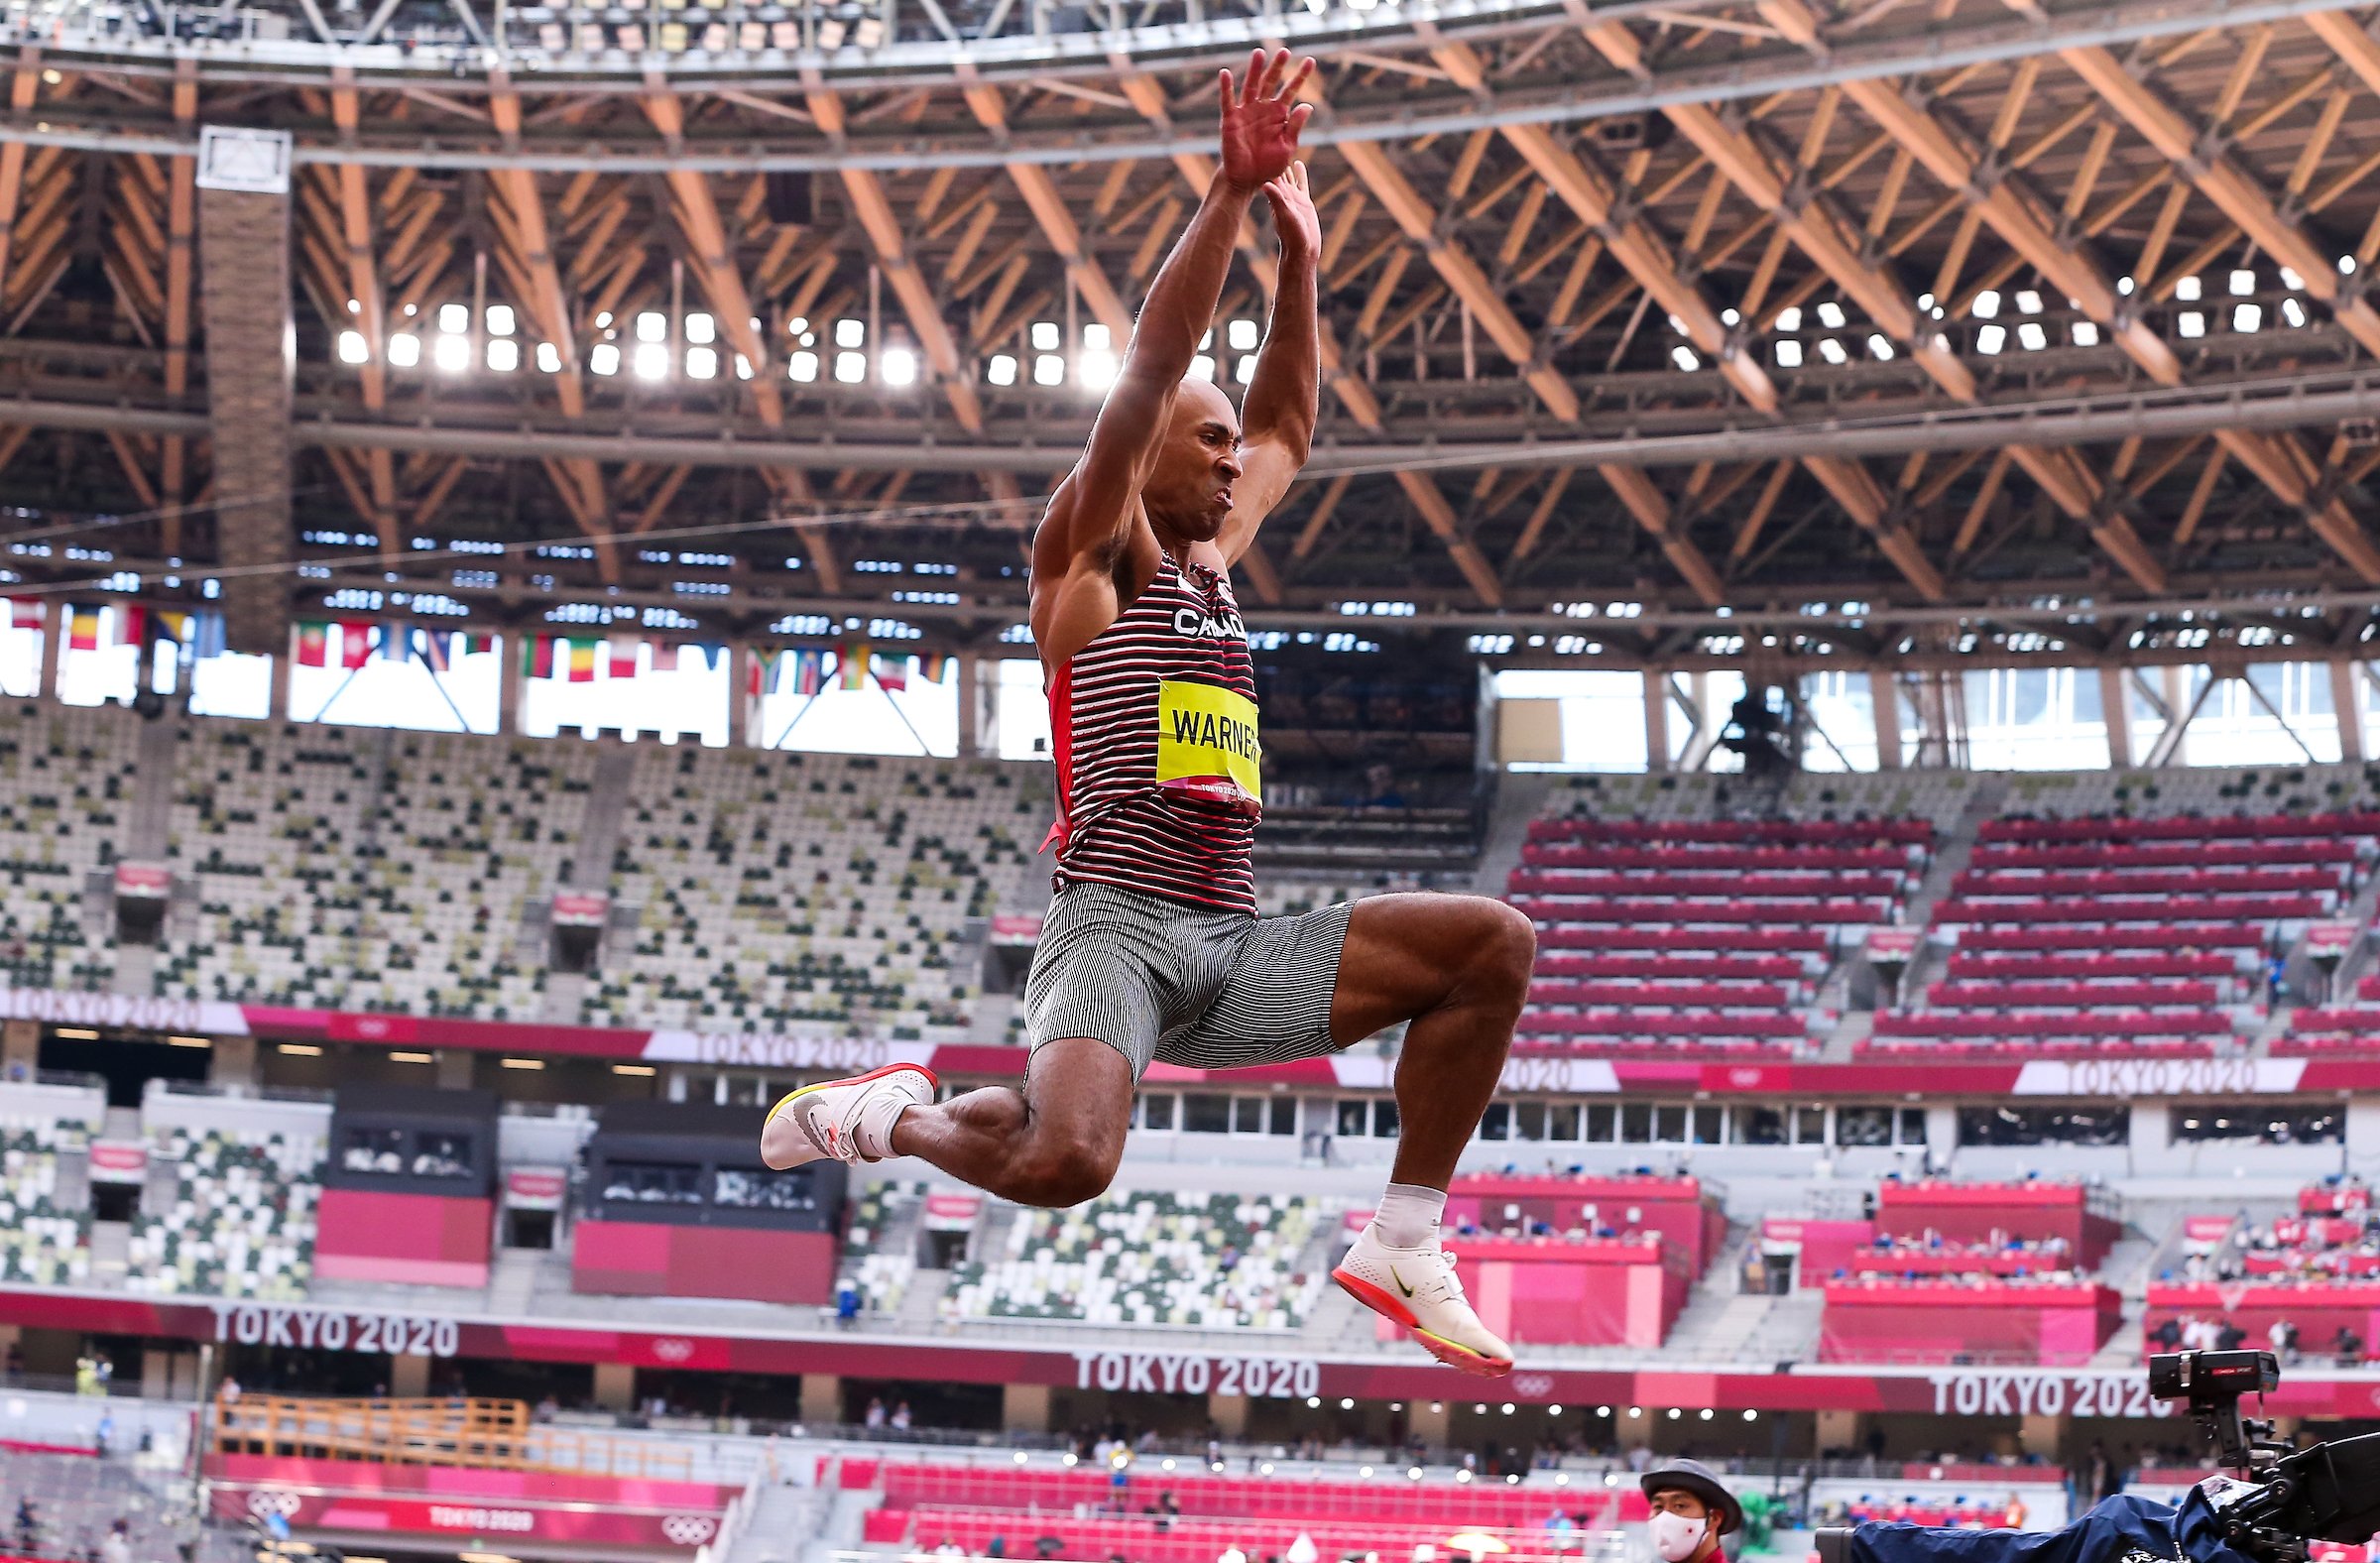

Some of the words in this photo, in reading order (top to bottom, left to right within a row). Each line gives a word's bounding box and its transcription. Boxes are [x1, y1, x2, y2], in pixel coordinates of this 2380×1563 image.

[1174, 608, 1248, 640] CANAD
[1172, 709, 1257, 764] WARNER
[1201, 783, 1224, 793] TOKYO
[694, 1031, 800, 1066] TOKYO
[810, 1035, 889, 1069] 2020
[2064, 1059, 2169, 1093] TOKYO
[2181, 1058, 2256, 1093] 2020
[209, 1305, 347, 1351] TOKYO
[354, 1315, 458, 1358] 2020
[1072, 1350, 1210, 1394] TOKYO
[1217, 1357, 1320, 1399] 2020
[1929, 1375, 2065, 1416] TOKYO
